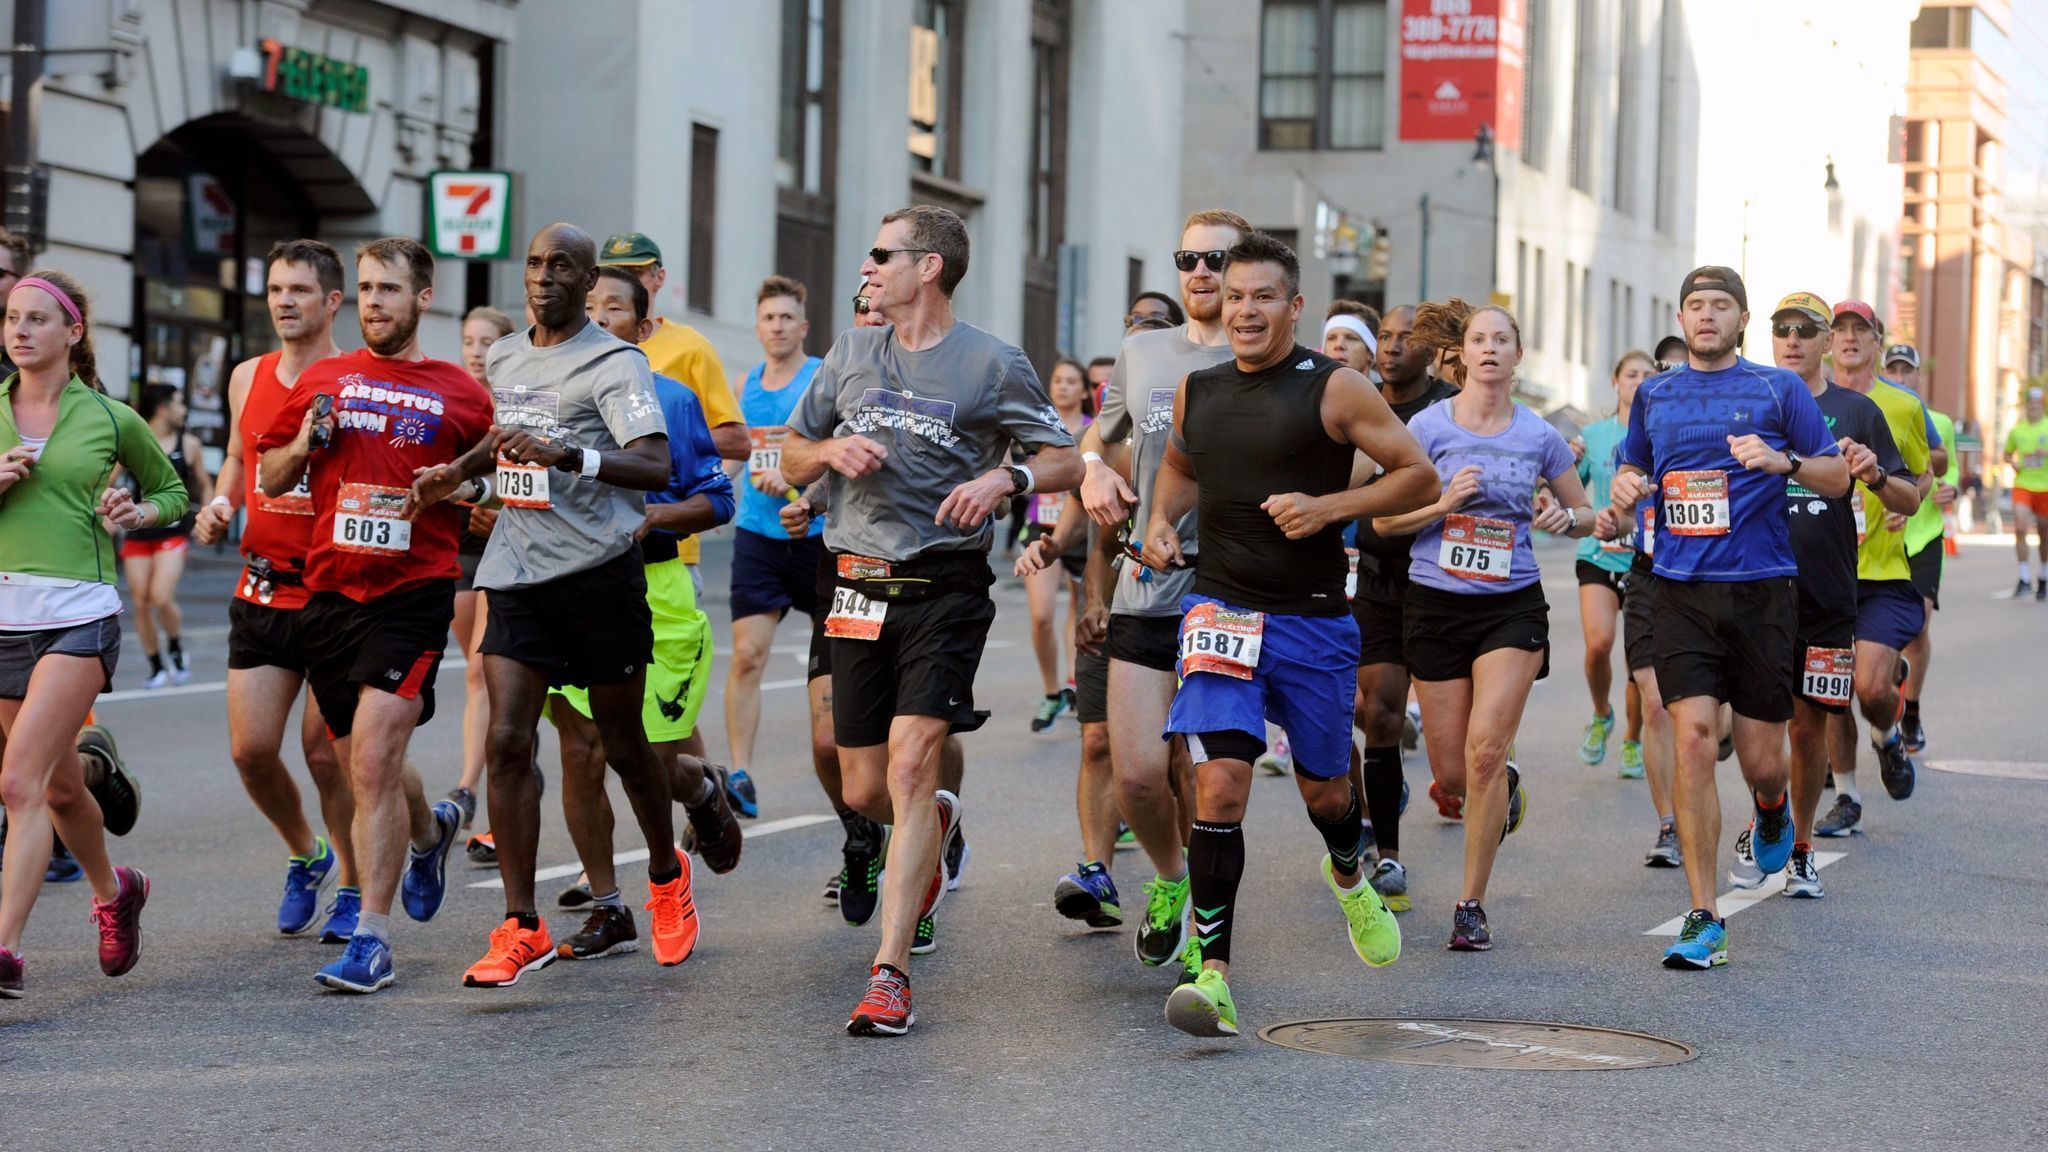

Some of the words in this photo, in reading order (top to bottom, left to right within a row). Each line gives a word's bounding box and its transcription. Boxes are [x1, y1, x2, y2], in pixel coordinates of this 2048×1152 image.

[448, 185, 491, 215] 7
[339, 384, 444, 416] ARBUTUS
[338, 410, 387, 433] RUN
[861, 406, 906, 416] RUNNING
[906, 411, 949, 428] FESTIVAL
[755, 452, 778, 469] 517
[499, 471, 534, 497] 1739
[1667, 503, 1715, 525] 1303
[344, 518, 391, 545] 603
[1450, 545, 1490, 571] 675
[1215, 623, 1257, 633] MARATHON
[1186, 630, 1245, 659] 1587
[1806, 675, 1849, 697] 1998
